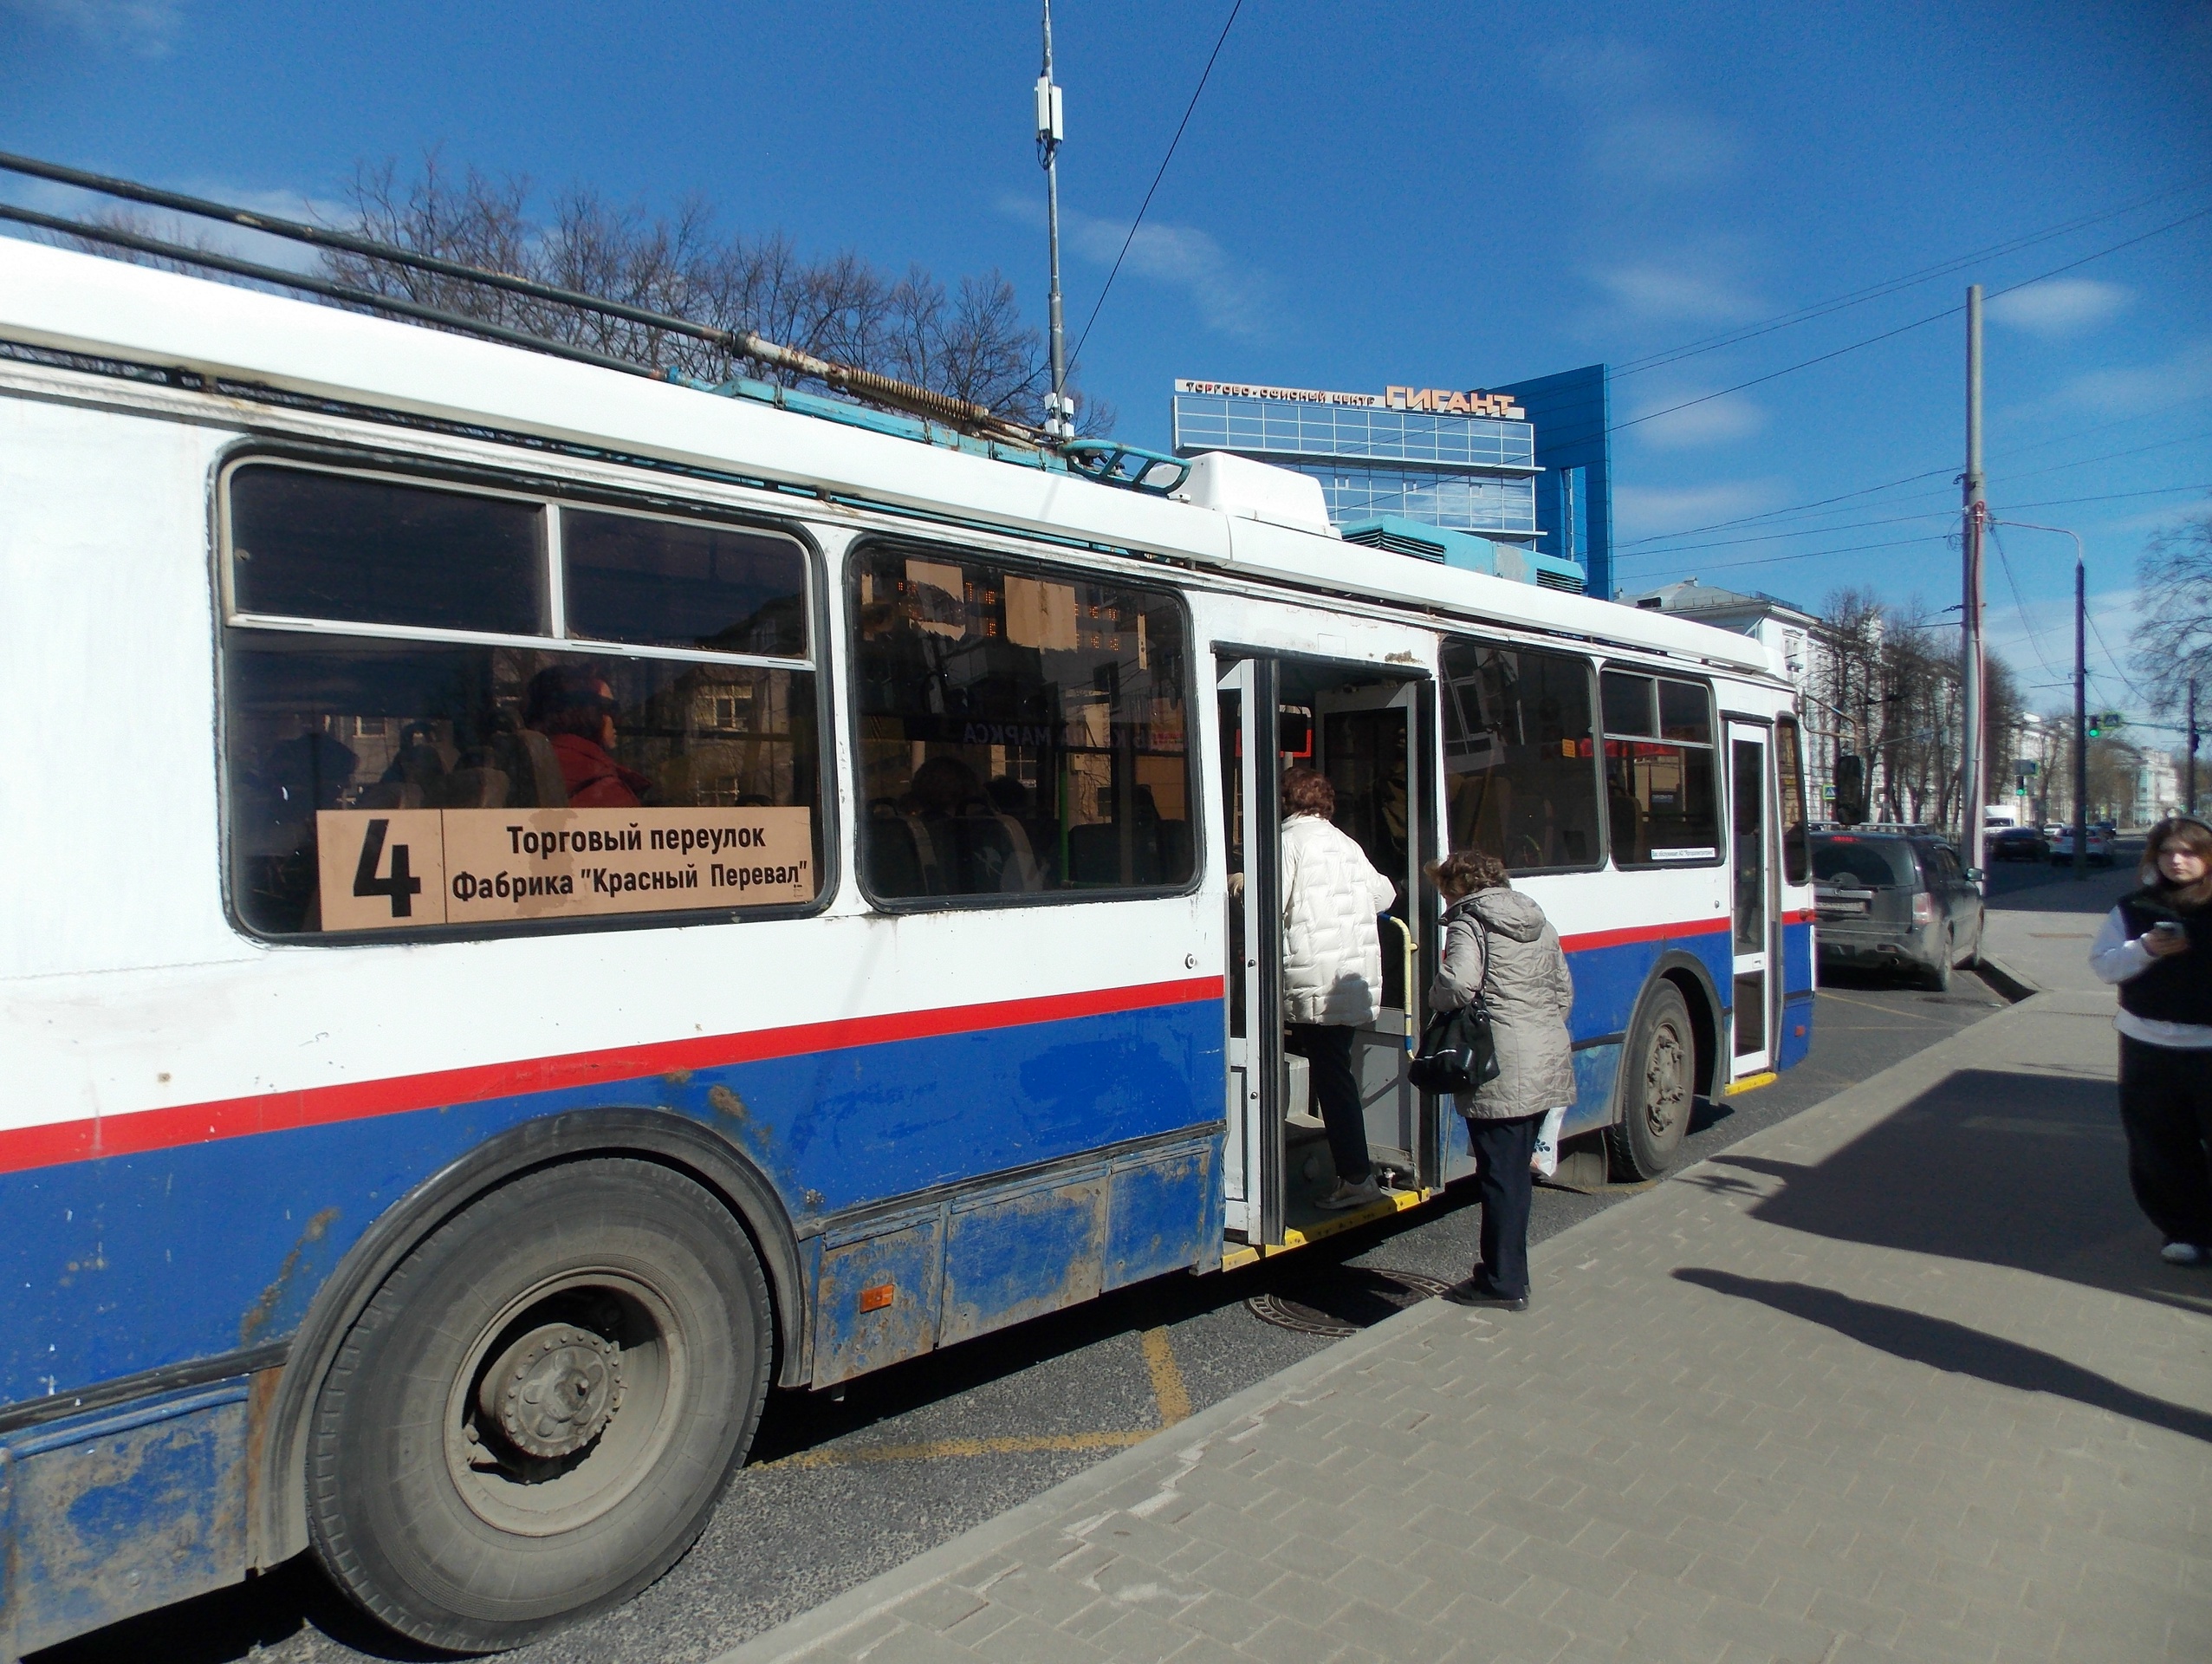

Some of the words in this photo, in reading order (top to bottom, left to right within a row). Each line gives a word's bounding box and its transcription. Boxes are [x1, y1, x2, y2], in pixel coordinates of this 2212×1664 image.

[1332, 393, 1375, 406] ЦЕНТР
[1385, 385, 1515, 417] ГИГАНТ
[506, 822, 642, 860] Торговый
[650, 828, 766, 855] переулок
[354, 819, 421, 918] 4
[452, 870, 574, 902] Фабрика
[581, 863, 697, 898] "Красный
[710, 861, 808, 891] Перевал"
